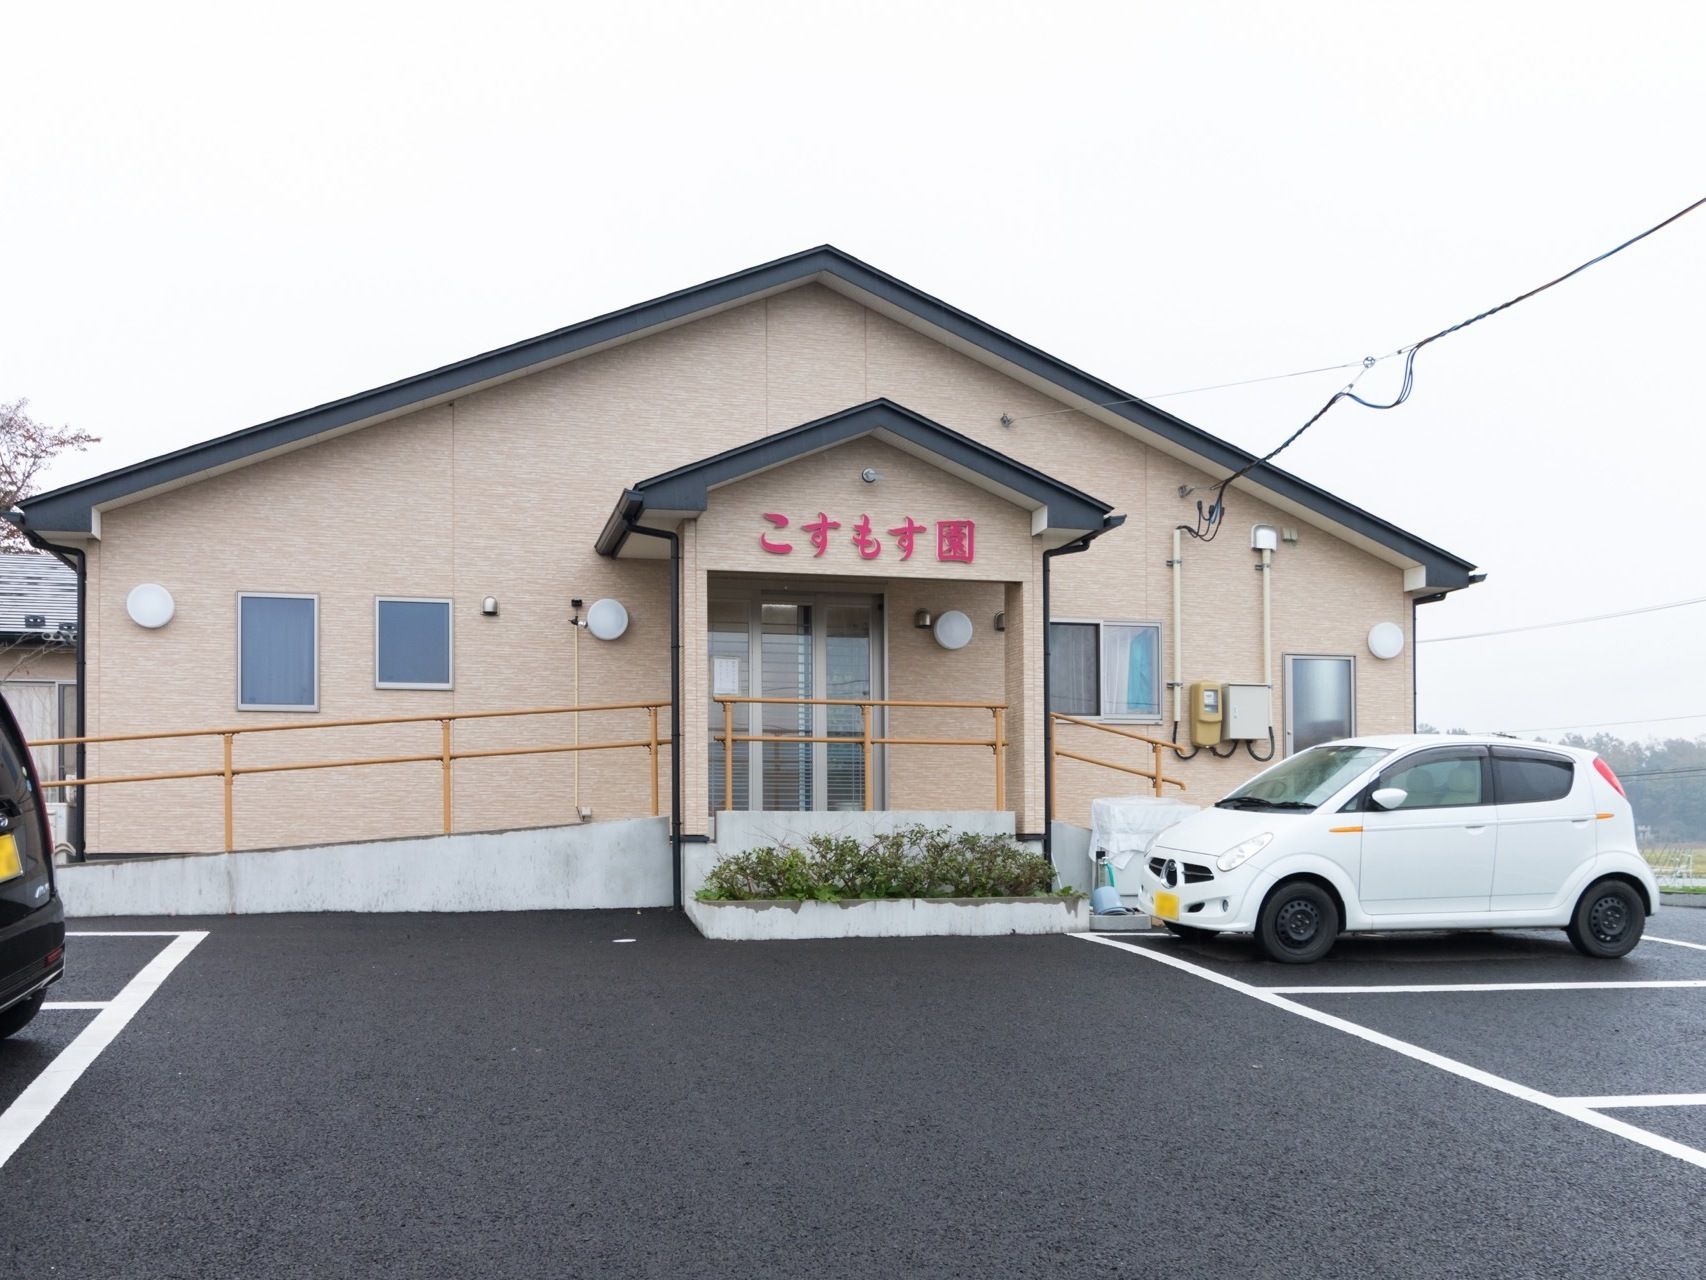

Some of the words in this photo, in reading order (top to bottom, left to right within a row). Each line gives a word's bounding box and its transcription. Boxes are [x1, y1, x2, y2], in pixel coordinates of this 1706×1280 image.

[760, 511, 975, 564] こすもす園
